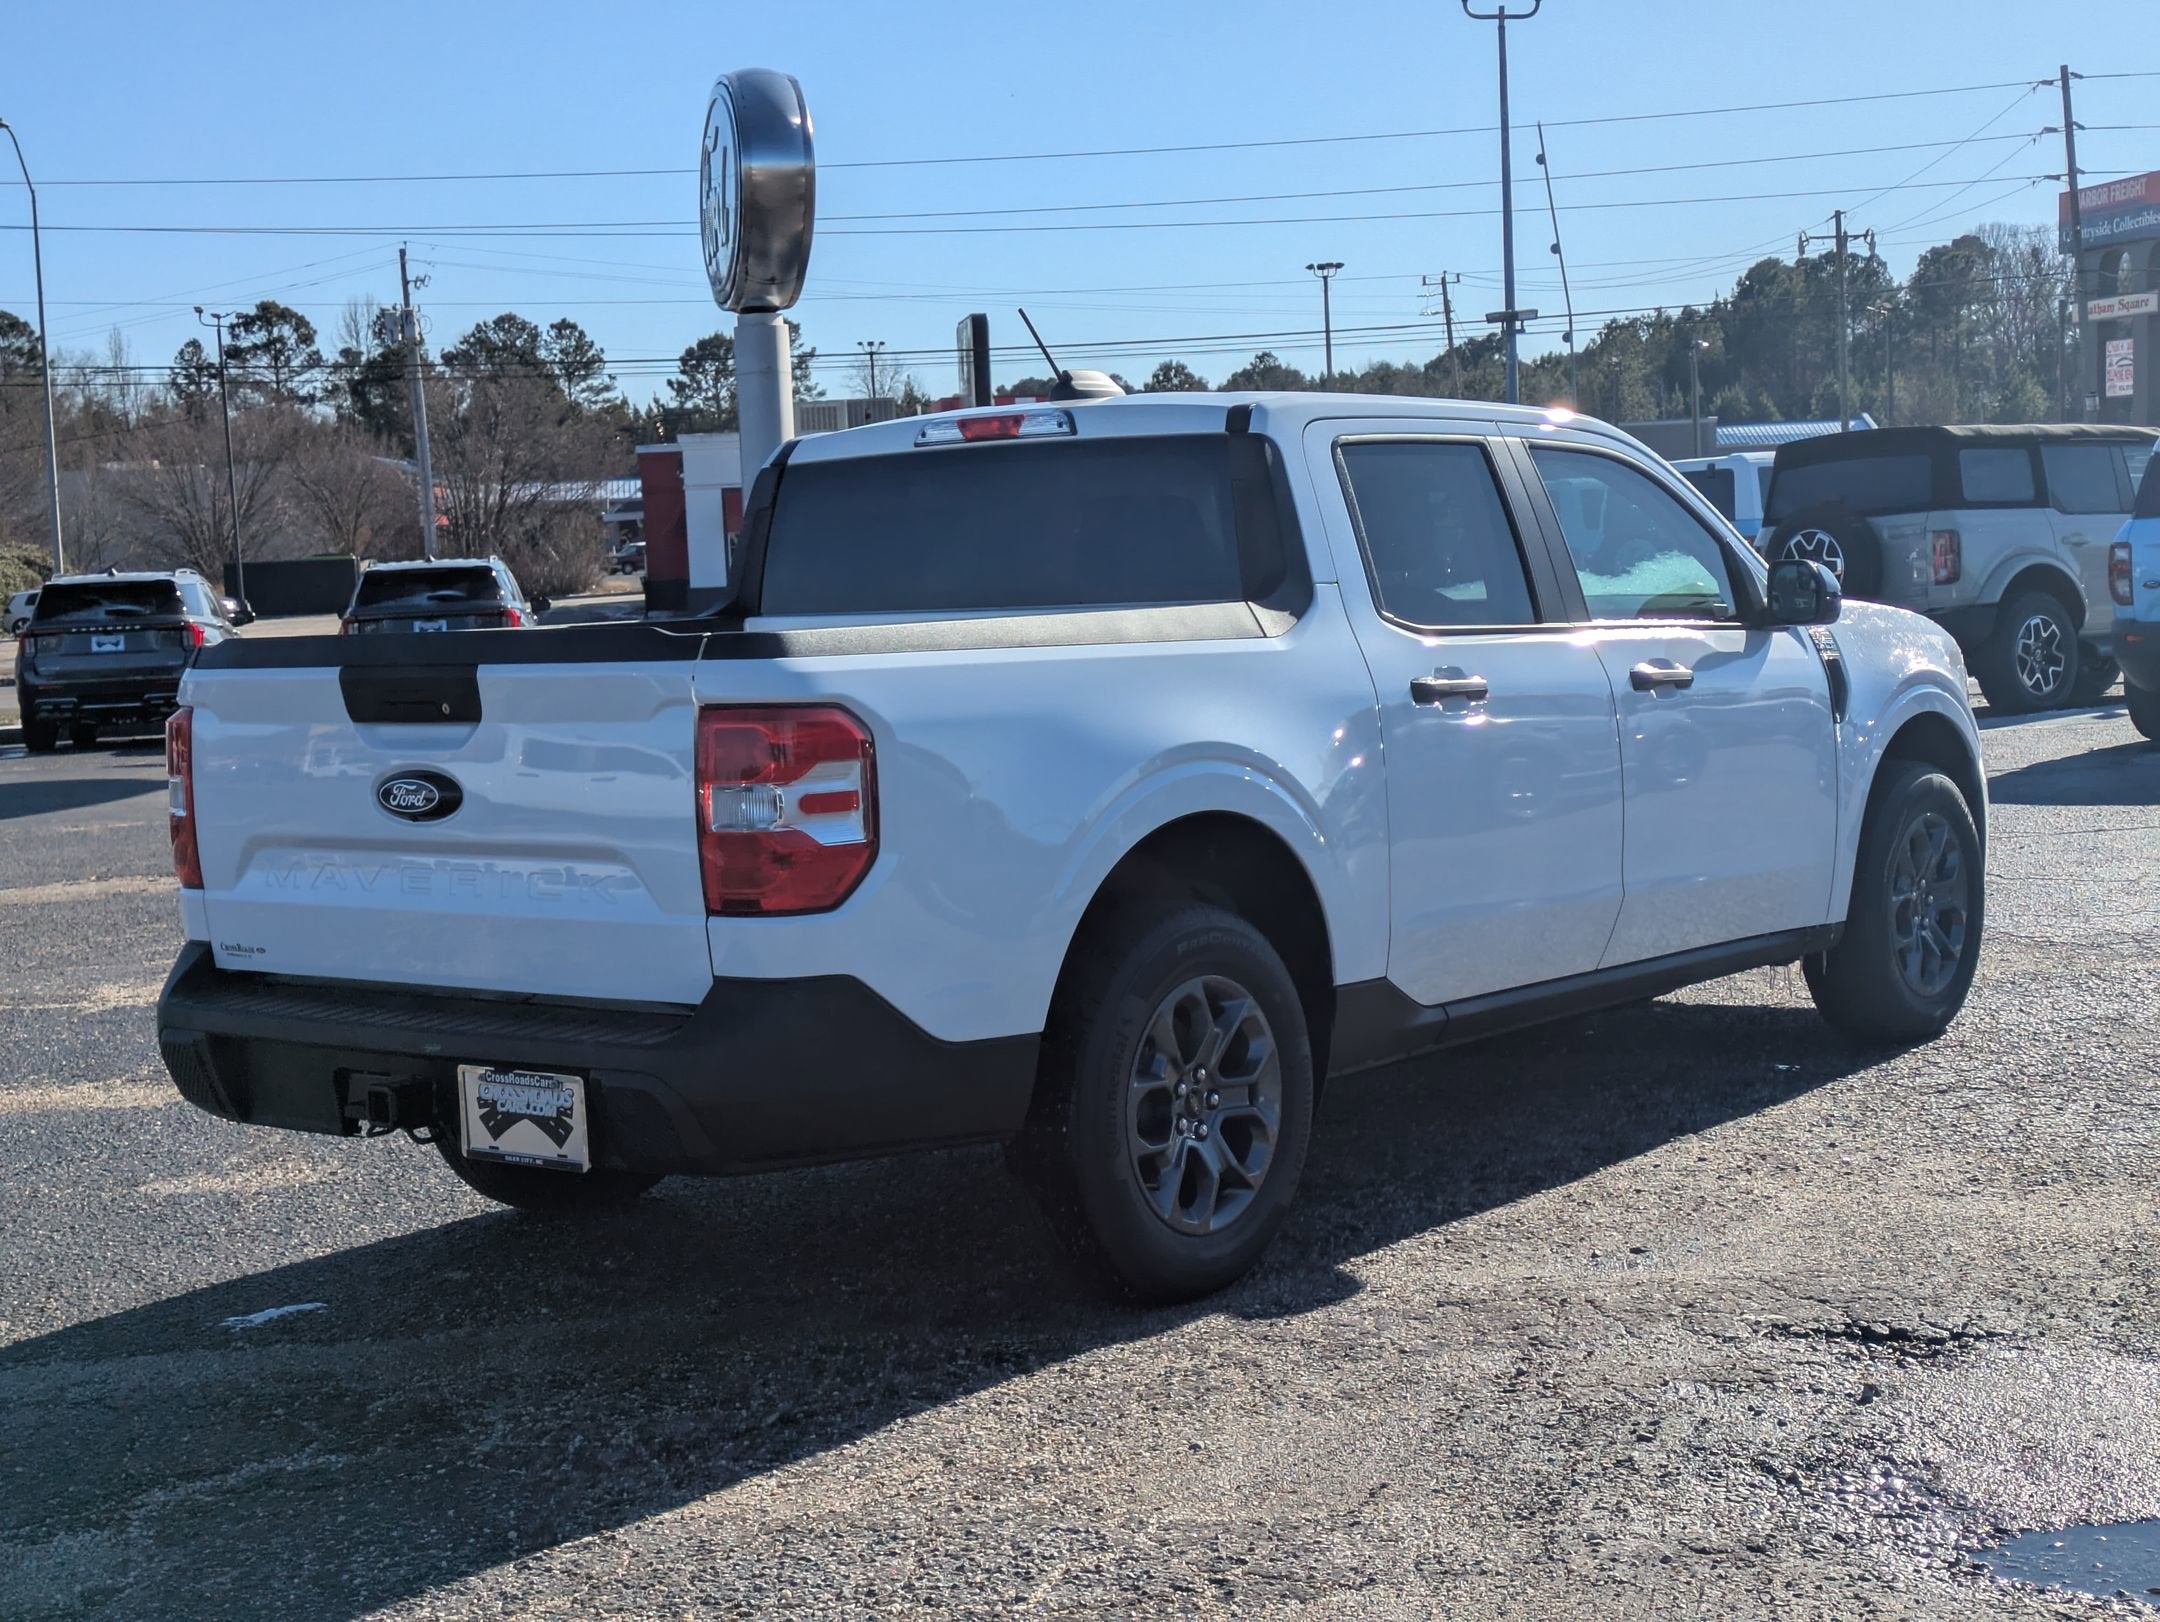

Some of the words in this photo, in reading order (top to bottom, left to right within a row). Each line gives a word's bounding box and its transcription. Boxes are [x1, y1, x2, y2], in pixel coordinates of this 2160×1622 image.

[2110, 178, 2147, 202] FREIGHT
[2089, 303, 2115, 316] atham
[2118, 298, 2149, 313] Square
[390, 783, 426, 807] Ford
[265, 863, 618, 905] MAVERICK
